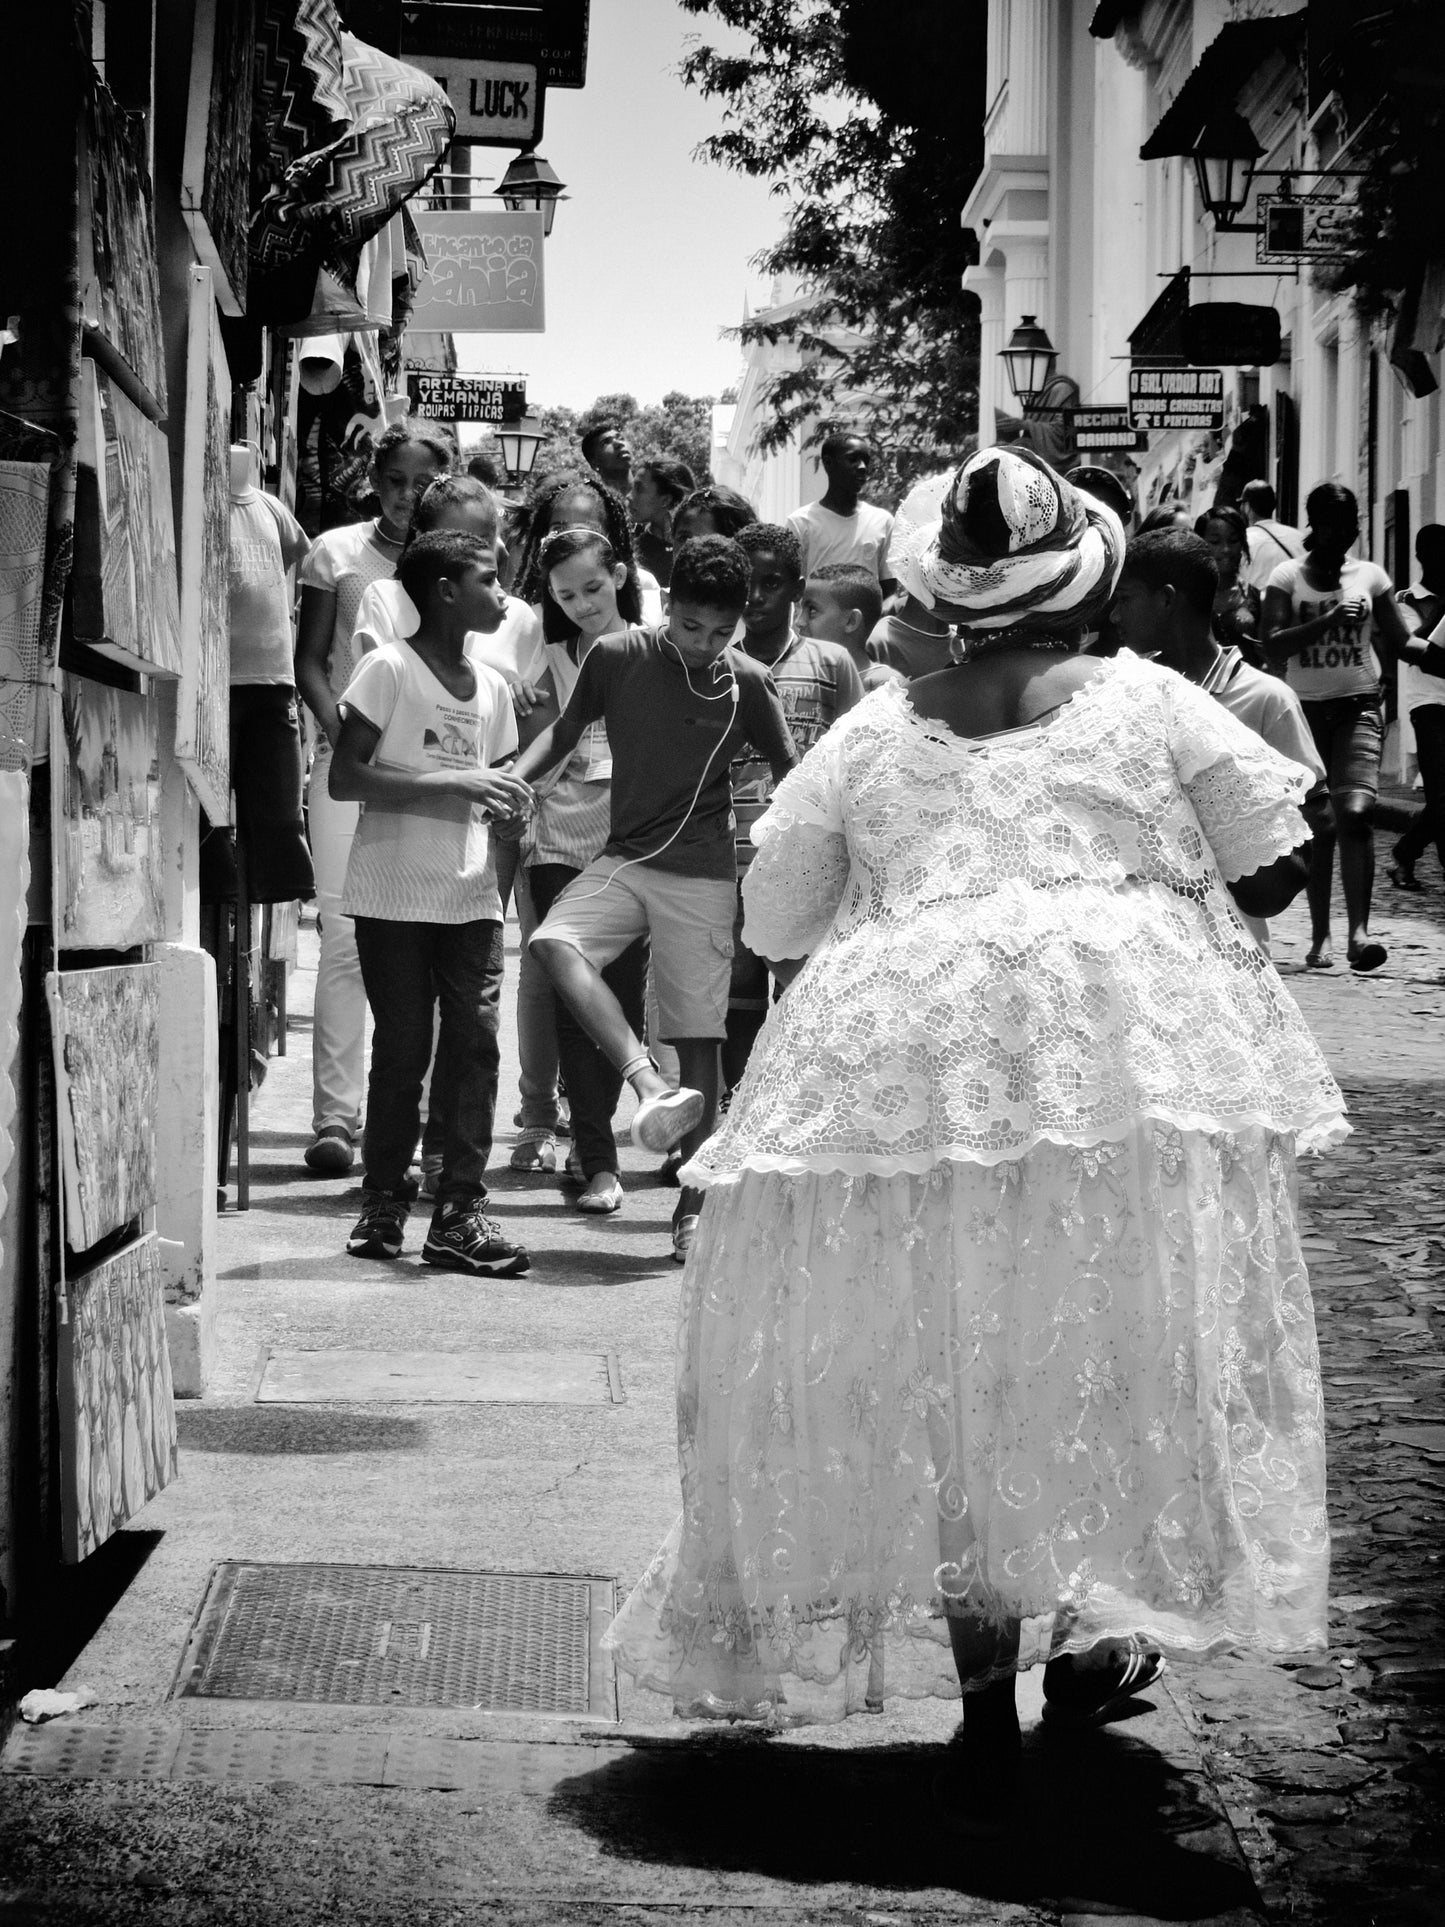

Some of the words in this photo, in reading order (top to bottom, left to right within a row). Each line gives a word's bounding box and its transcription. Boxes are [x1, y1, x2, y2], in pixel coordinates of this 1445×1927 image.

[469, 78, 529, 118] LUCK
[422, 233, 506, 258] Encanto
[506, 233, 534, 258] da
[418, 377, 525, 392] ARTESANATO
[1140, 373, 1198, 394] SALVADOR
[1199, 373, 1221, 394] ART
[418, 390, 503, 405] YEMANJA
[417, 404, 456, 417] ROUPAS
[462, 405, 504, 420] TIPICAS
[1169, 399, 1223, 413] CAMISETAS
[1073, 413, 1128, 427] RECANT
[1153, 415, 1161, 427] E
[1163, 415, 1213, 427] PINTURAS
[1076, 432, 1137, 448] BAHIANO
